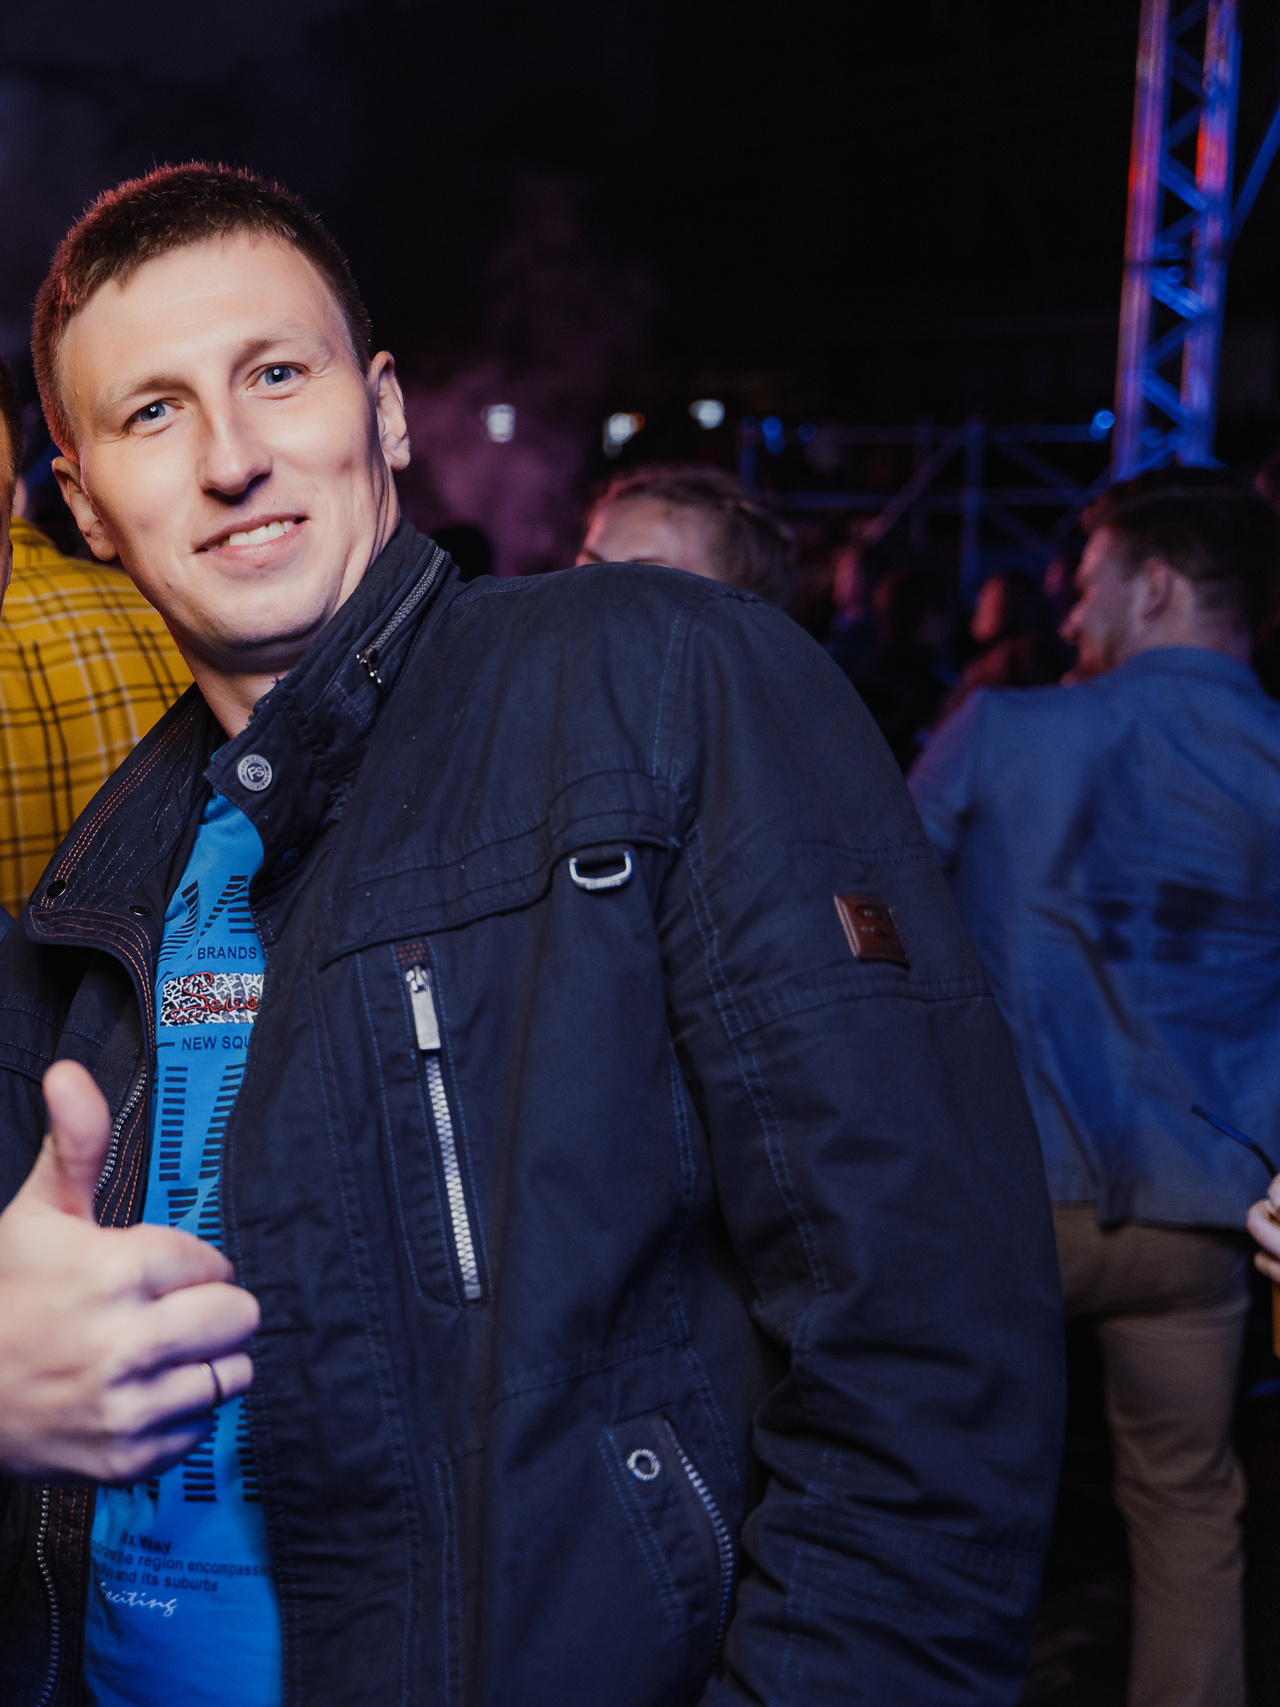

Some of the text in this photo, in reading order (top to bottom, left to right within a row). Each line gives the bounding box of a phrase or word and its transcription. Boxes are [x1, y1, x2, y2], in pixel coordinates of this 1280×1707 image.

[197, 946, 257, 960] BRANDS
[182, 1036, 218, 1051] NEW
[138, 1554, 184, 1572] region
[140, 1570, 159, 1586] its
[164, 1575, 219, 1593] suburbs
